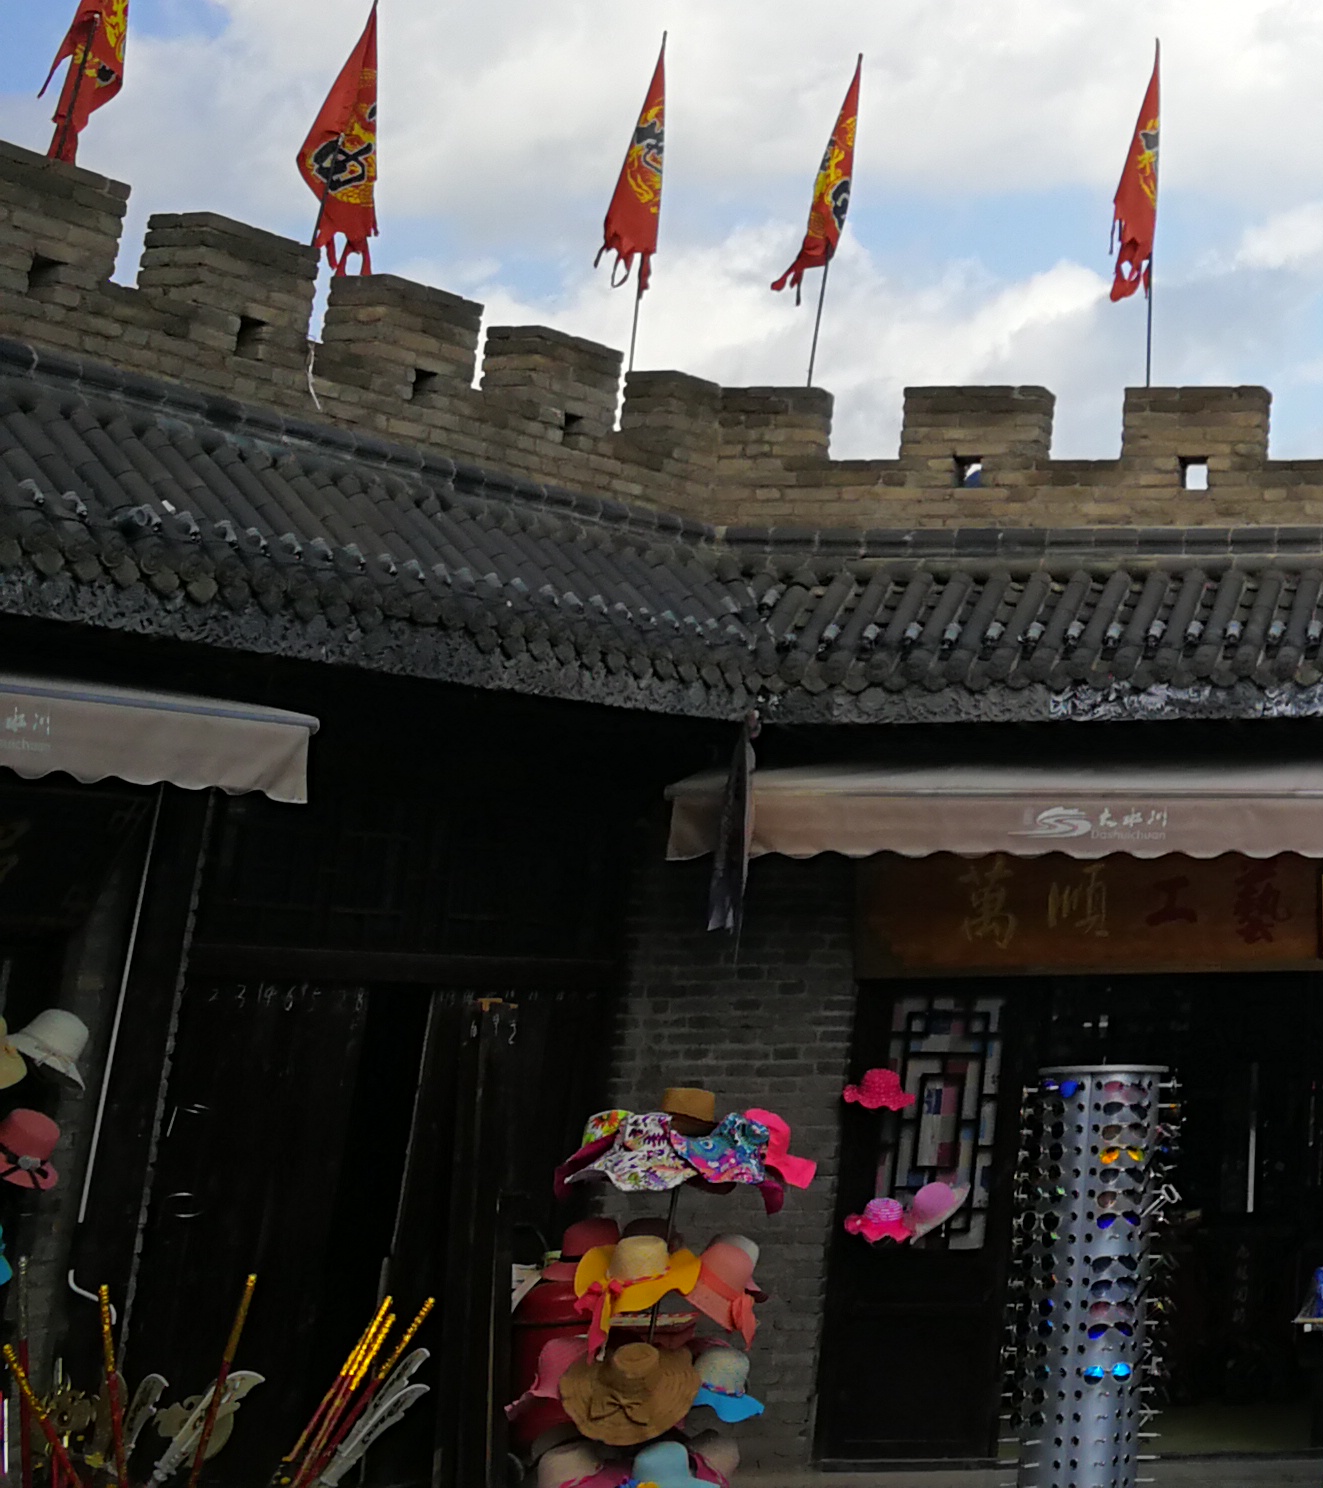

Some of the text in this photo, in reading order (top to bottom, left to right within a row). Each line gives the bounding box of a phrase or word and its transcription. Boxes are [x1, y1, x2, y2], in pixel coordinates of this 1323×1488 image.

[1099, 806, 1168, 829] 大水川
[1090, 829, 1167, 841] Dashuichuan
